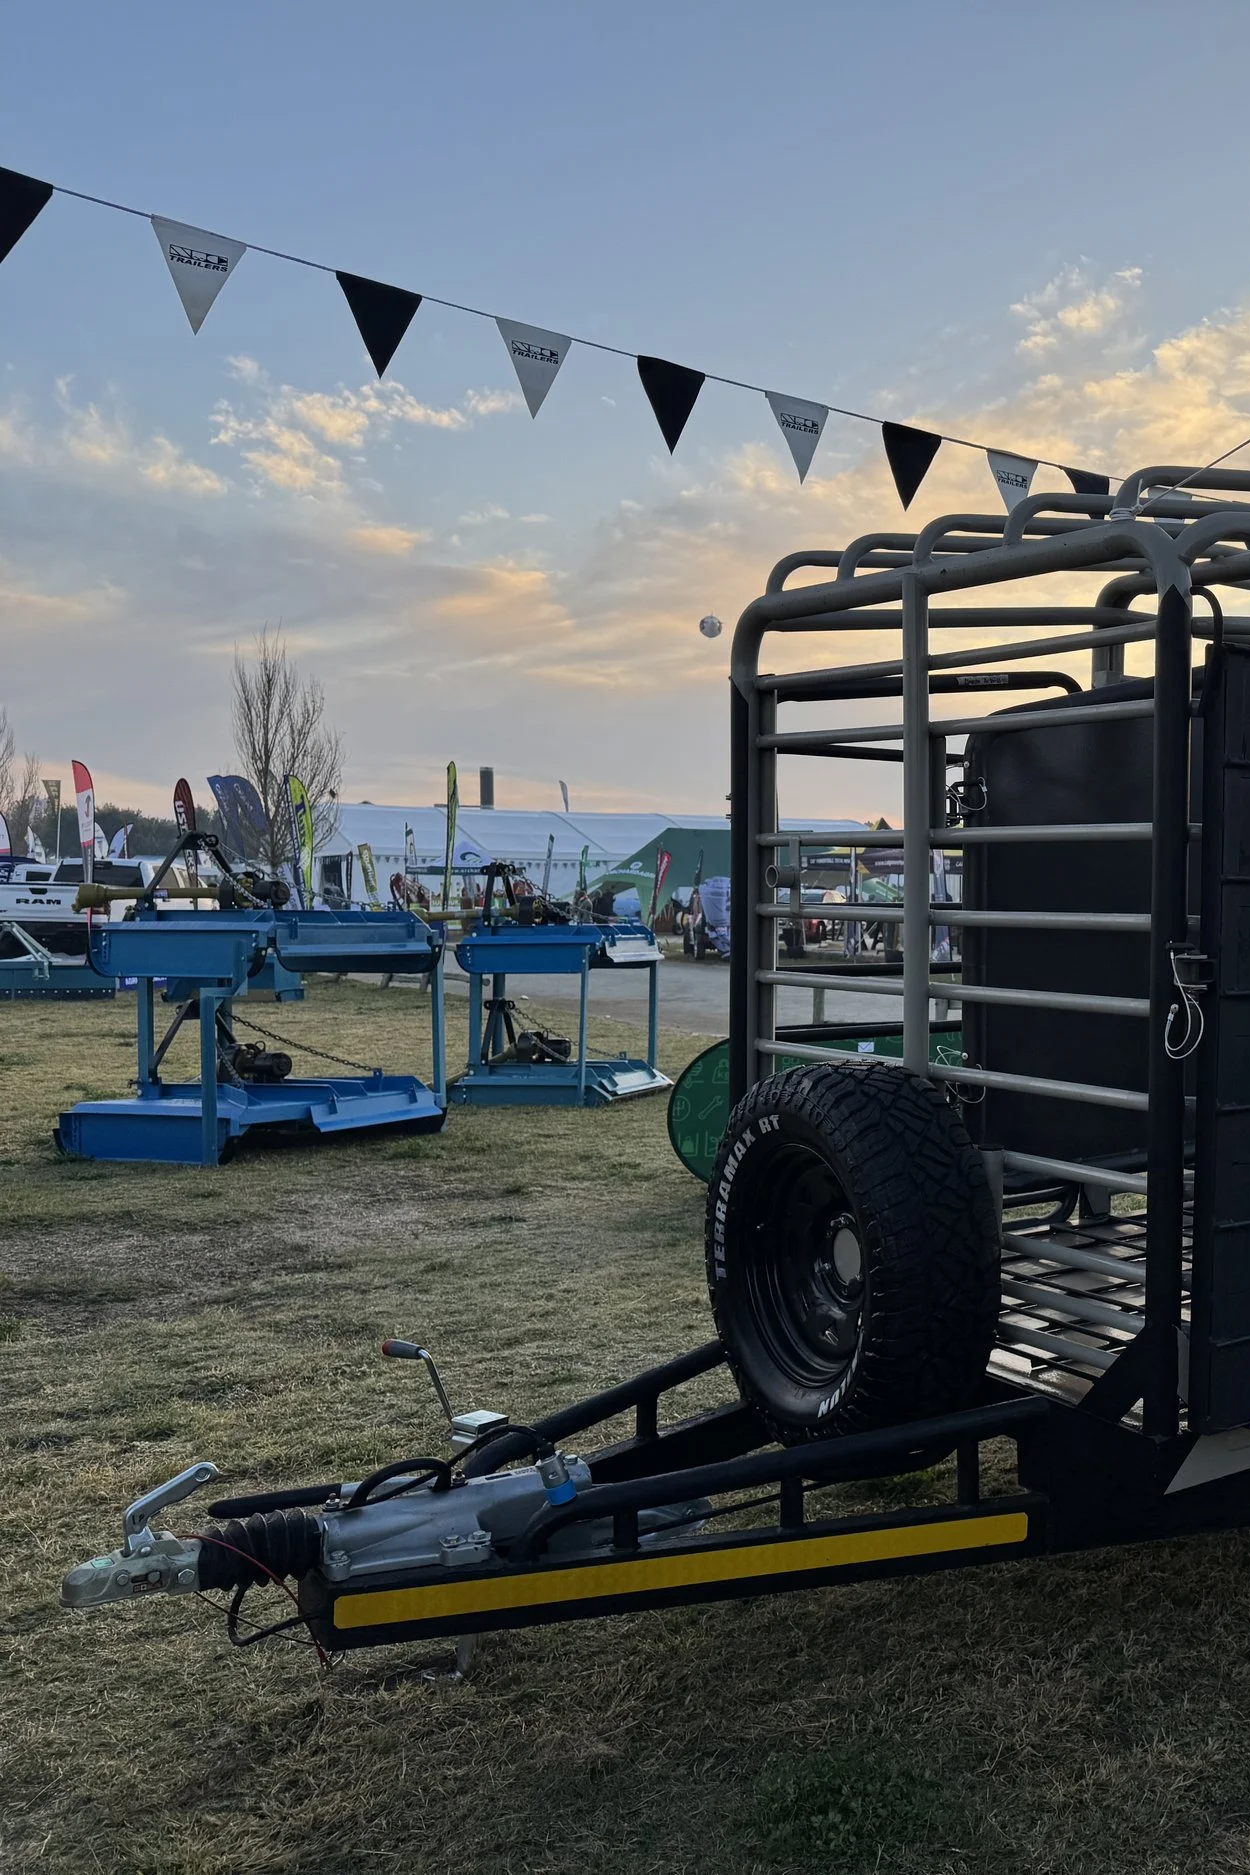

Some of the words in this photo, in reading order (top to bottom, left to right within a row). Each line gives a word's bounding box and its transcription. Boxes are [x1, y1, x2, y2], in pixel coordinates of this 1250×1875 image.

[169, 255, 228, 272] TRAILERS
[512, 350, 559, 364] TRAILERS
[714, 1129, 757, 1282] TERRAMAX
[758, 1113, 780, 1135] RT
